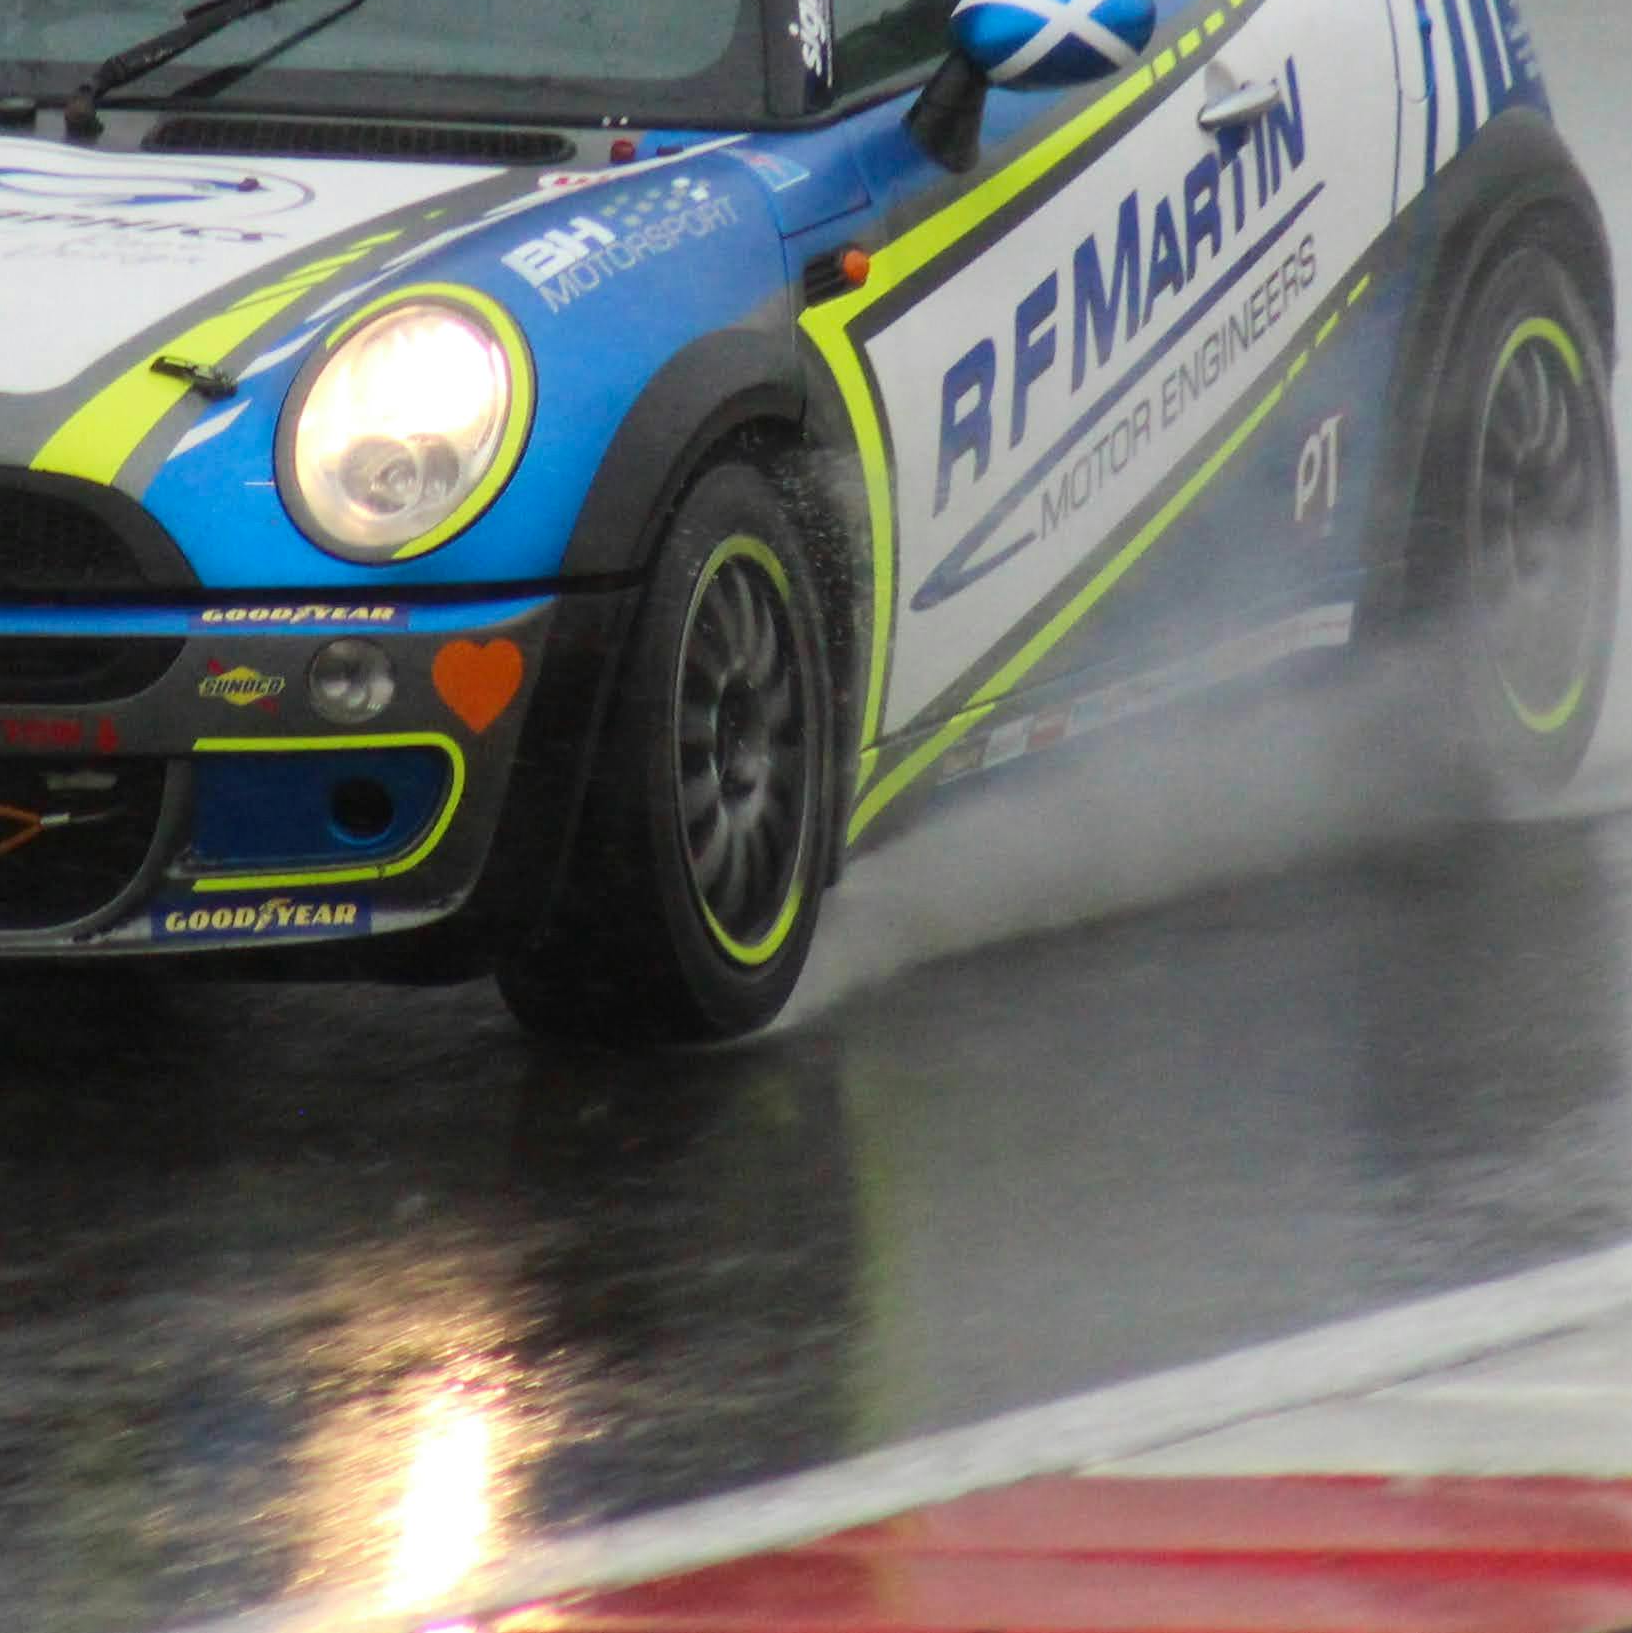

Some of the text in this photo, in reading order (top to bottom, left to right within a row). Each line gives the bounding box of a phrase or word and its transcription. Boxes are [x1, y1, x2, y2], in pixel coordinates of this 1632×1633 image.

[500, 216, 617, 289] BH
[539, 193, 739, 314] MOTORSPORT
[1041, 232, 1317, 541] MOTOR ENGINEERS
[200, 603, 395, 625] GOODYEAR
[198, 675, 286, 697] SUNOCO
[165, 897, 358, 934] GOODYEAR
